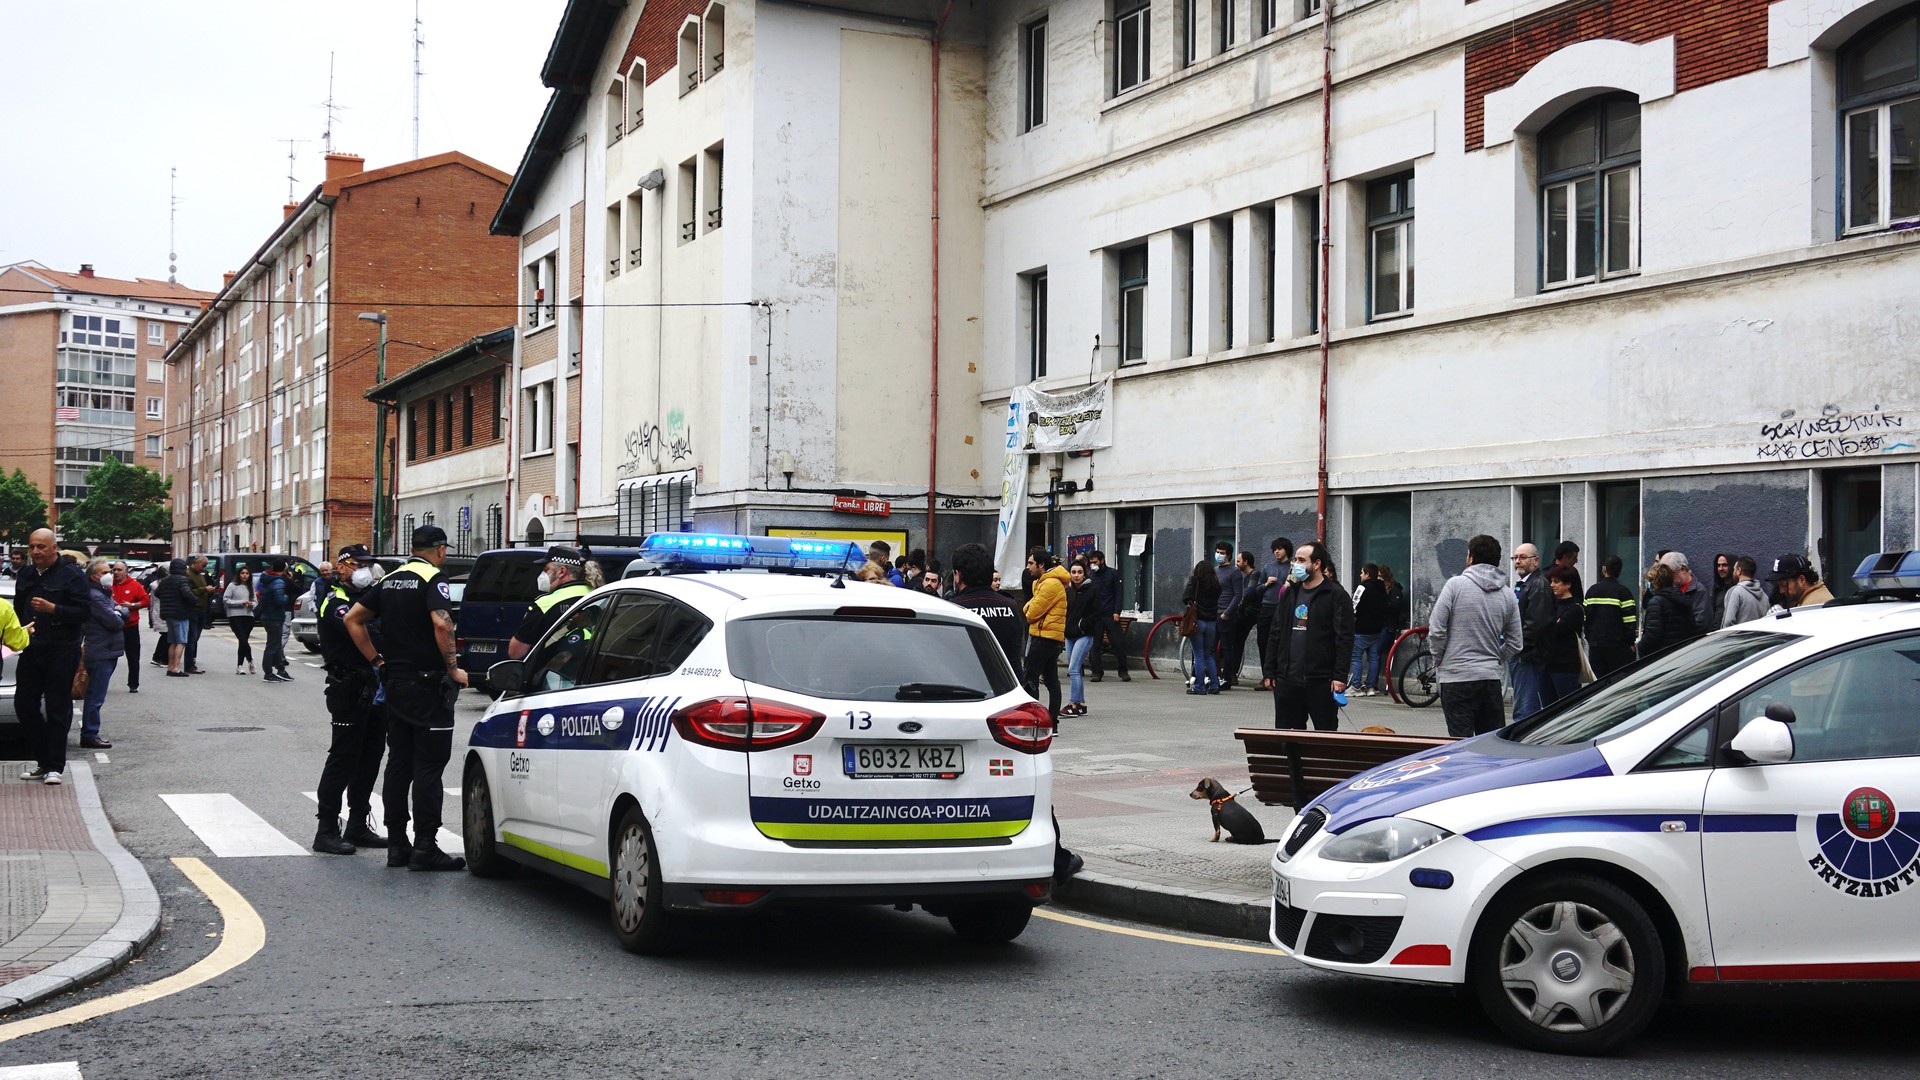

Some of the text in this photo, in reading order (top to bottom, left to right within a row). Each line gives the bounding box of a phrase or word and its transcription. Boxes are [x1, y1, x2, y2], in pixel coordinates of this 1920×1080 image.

[863, 502, 886, 512] LIBRE!
[559, 604, 570, 613] UD
[970, 606, 1015, 618] ZAINTZA
[561, 715, 601, 736] POLIZIA
[845, 710, 872, 730] 13
[510, 751, 530, 773] Getxo
[859, 748, 911, 769] 6032
[917, 747, 956, 768] KBZ
[783, 776, 821, 789] Getxo
[808, 804, 991, 819] UDALTZAINGOA-POLIZIA
[1808, 851, 1920, 898] ERTZAINTZ
